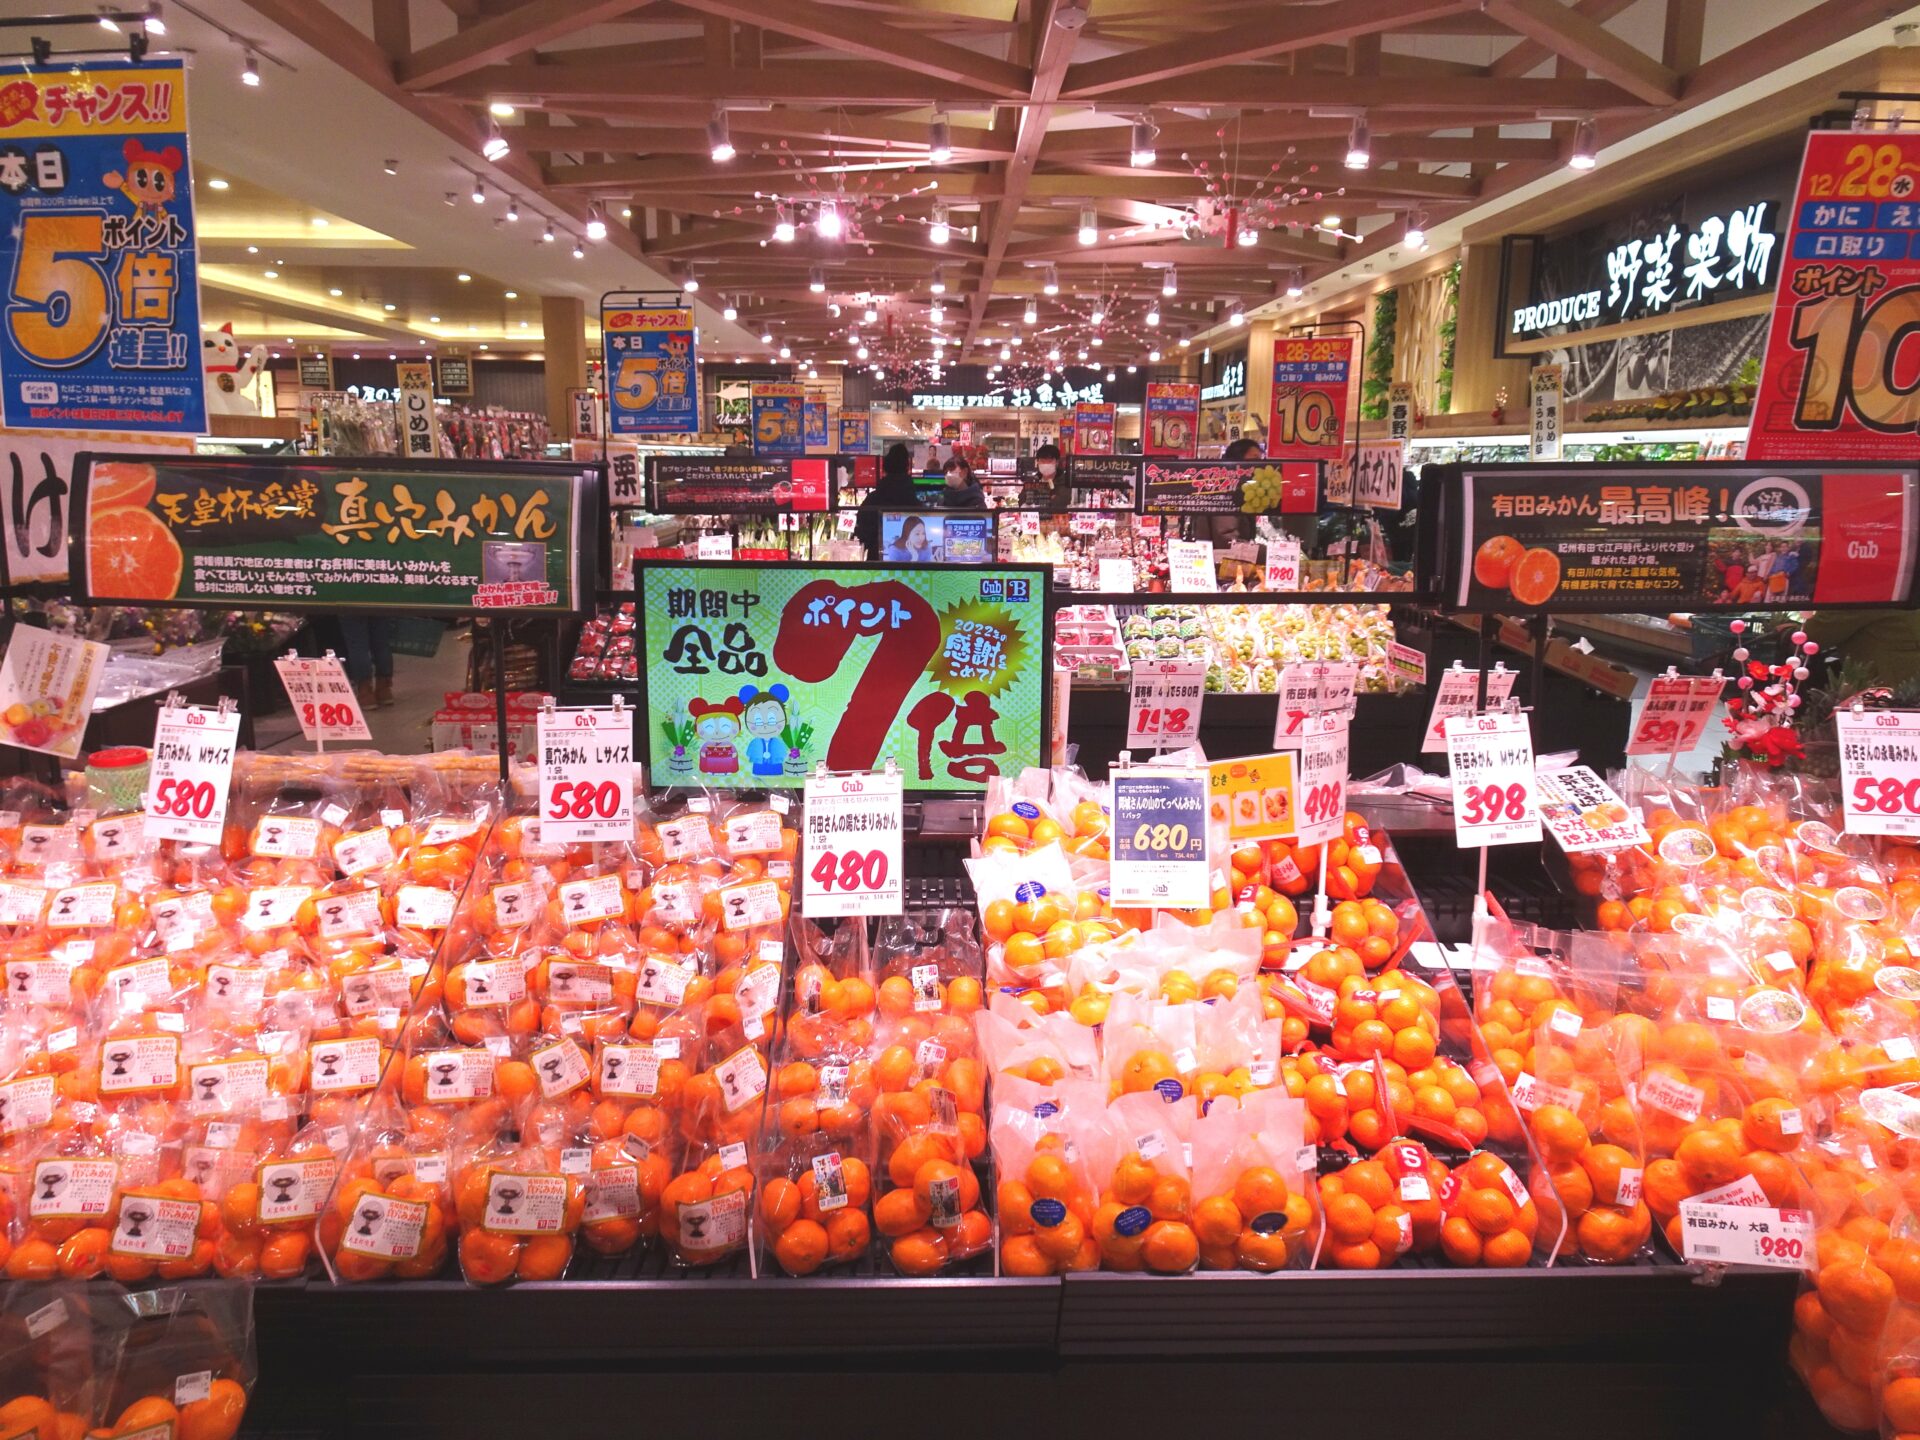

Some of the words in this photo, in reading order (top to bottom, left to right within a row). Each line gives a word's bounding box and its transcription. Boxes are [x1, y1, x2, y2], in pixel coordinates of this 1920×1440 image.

[0, 152, 65, 190] 本日
[1814, 205, 1861, 226] かに
[103, 216, 186, 248] ポイント
[1815, 237, 1885, 256] 口取り
[1607, 202, 1776, 317] 野菜果物
[9, 213, 107, 363] 5
[116, 252, 176, 322] 倍
[1794, 266, 1885, 296] ポイント
[1513, 291, 1601, 334] PRODUCE
[615, 357, 658, 410] 5
[1012, 382, 1103, 409] お魚市場
[912, 394, 965, 407] FRESH
[967, 394, 1005, 407] FISH
[408, 392, 432, 454] しめ縄
[756, 411, 782, 443] 5
[1277, 391, 1335, 444] 10
[156, 479, 319, 526] 天皇杯受賞
[321, 477, 557, 545] 真穴みかん
[1027, 522, 1038, 530] 98
[1080, 522, 1095, 530] 298
[1848, 540, 1879, 559] Cub
[982, 581, 1002, 594] Cub
[1181, 577, 1207, 587] 1980
[1268, 566, 1295, 581] 1980
[667, 588, 761, 619] 期間中
[803, 596, 913, 629] ポイント
[663, 622, 769, 678] 全品
[943, 633, 1009, 671] 感謝を
[773, 579, 942, 776] 7
[949, 661, 996, 685] こめて!
[187, 713, 206, 725] Cub
[575, 715, 597, 726] Cub
[1876, 715, 1900, 726] Cub
[906, 690, 1009, 784] 倍
[157, 742, 193, 763] 真穴みかん
[199, 746, 231, 765] Mサイズ
[545, 747, 587, 765] 真穴みかん
[596, 745, 629, 764] Lサイズ
[154, 778, 216, 819] 580
[548, 780, 621, 820] 580
[841, 781, 864, 793] Cub
[1304, 780, 1341, 823] 498
[1851, 777, 1920, 815] 580
[1462, 782, 1527, 825] 398
[1133, 824, 1188, 851] 680
[1190, 838, 1202, 851] 円
[811, 849, 888, 892] 480
[1400, 1147, 1422, 1168] S
[1439, 1177, 1455, 1200] S
[1687, 1217, 1739, 1231] 有田みかん
[1748, 1221, 1770, 1233] 大袋
[1760, 1236, 1803, 1259] 980
